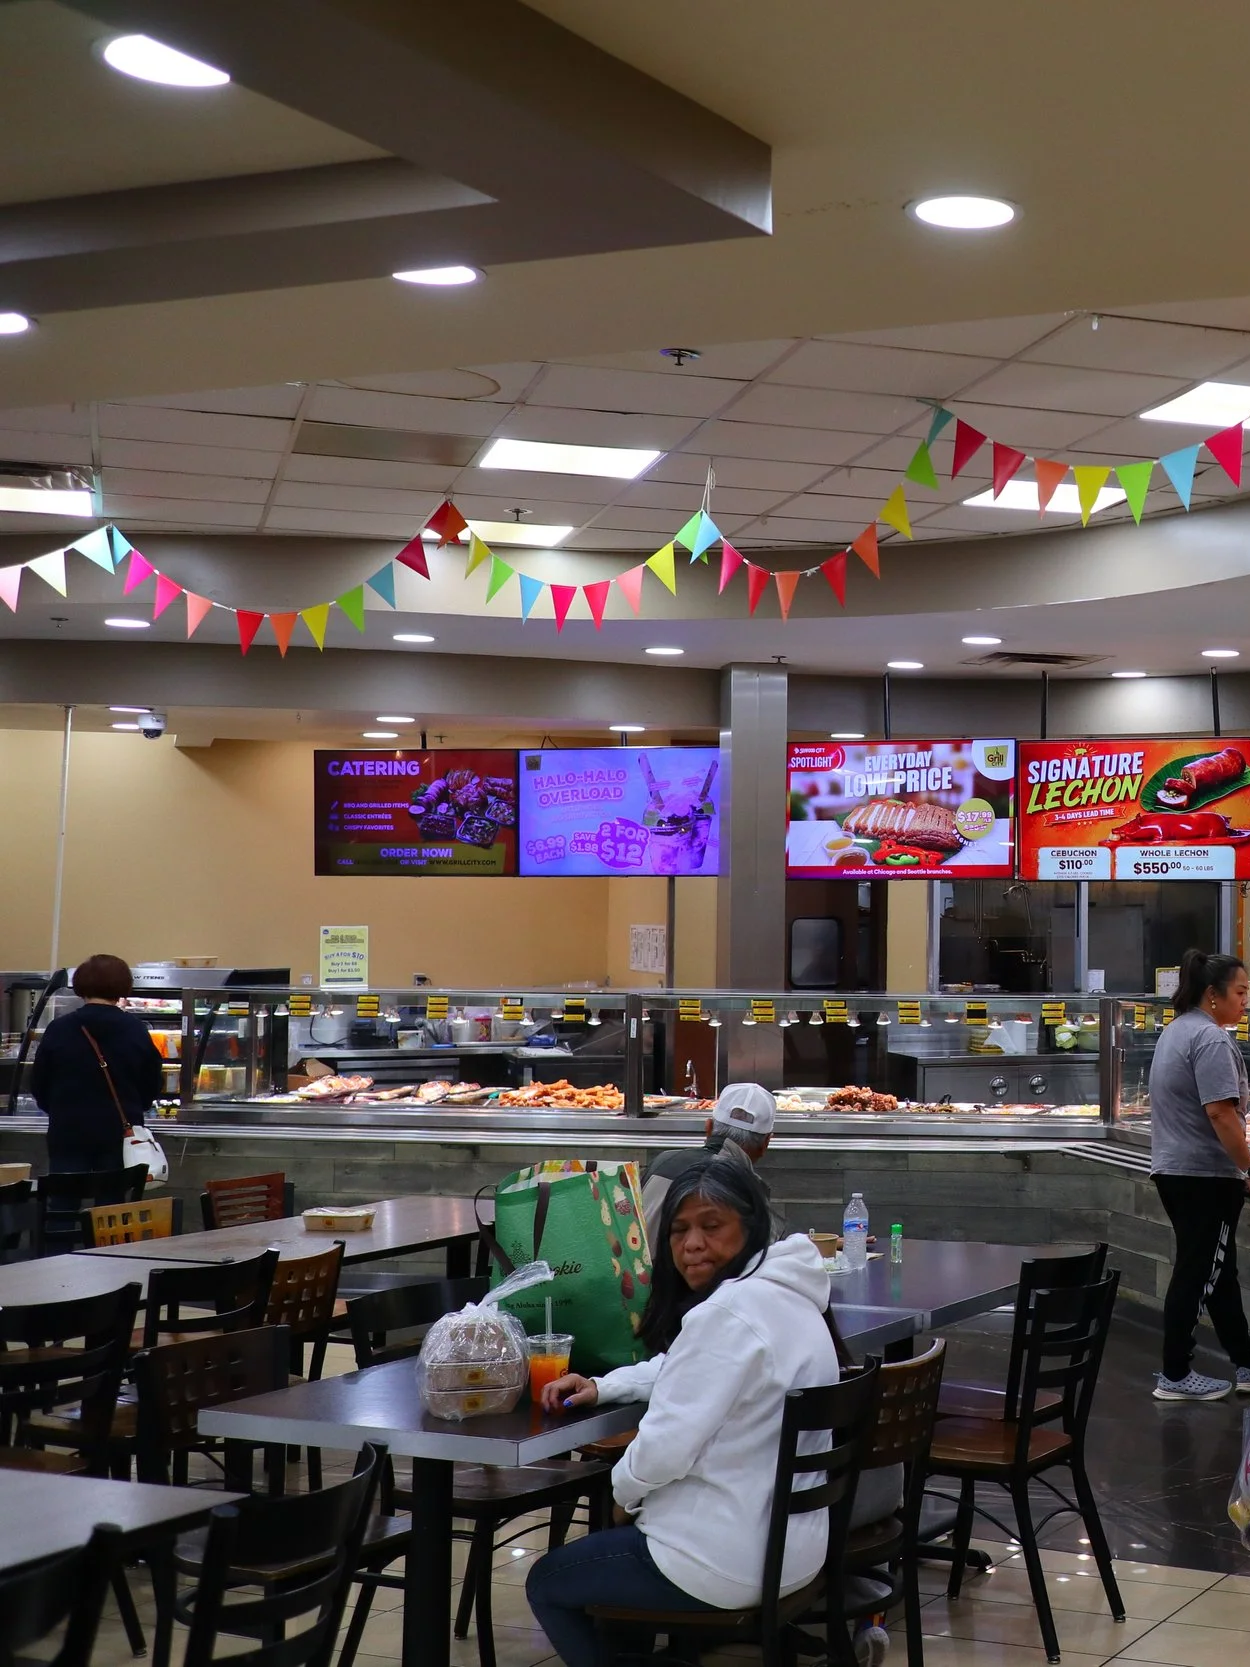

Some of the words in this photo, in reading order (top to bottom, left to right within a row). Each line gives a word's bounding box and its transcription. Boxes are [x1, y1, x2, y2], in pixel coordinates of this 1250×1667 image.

[791, 757, 832, 768] SPOTLIGHT
[864, 751, 933, 772] EVERYDAY
[987, 754, 1004, 763] Grill
[327, 760, 420, 776] CATERING
[1028, 752, 1144, 784] SIGNATURE
[533, 769, 627, 789] HALO-HALO
[844, 772, 888, 798] LOW
[894, 766, 952, 794] PRICE
[539, 787, 623, 805] OVERLOAD
[1026, 773, 1144, 814] LECHON
[1066, 812, 1082, 820] DAYS
[1100, 808, 1114, 816] TIME
[574, 833, 597, 841] SAVE
[601, 824, 611, 837] 2
[616, 825, 647, 842] FOR
[380, 848, 418, 858] ORDER
[422, 848, 453, 858] NOW!
[536, 849, 564, 863] EACH
[601, 839, 642, 865] $12
[1059, 859, 1093, 870] $110.00
[1133, 861, 1181, 875] $550.00
[352, 951, 364, 960] $10
[550, 1260, 582, 1277] okie
